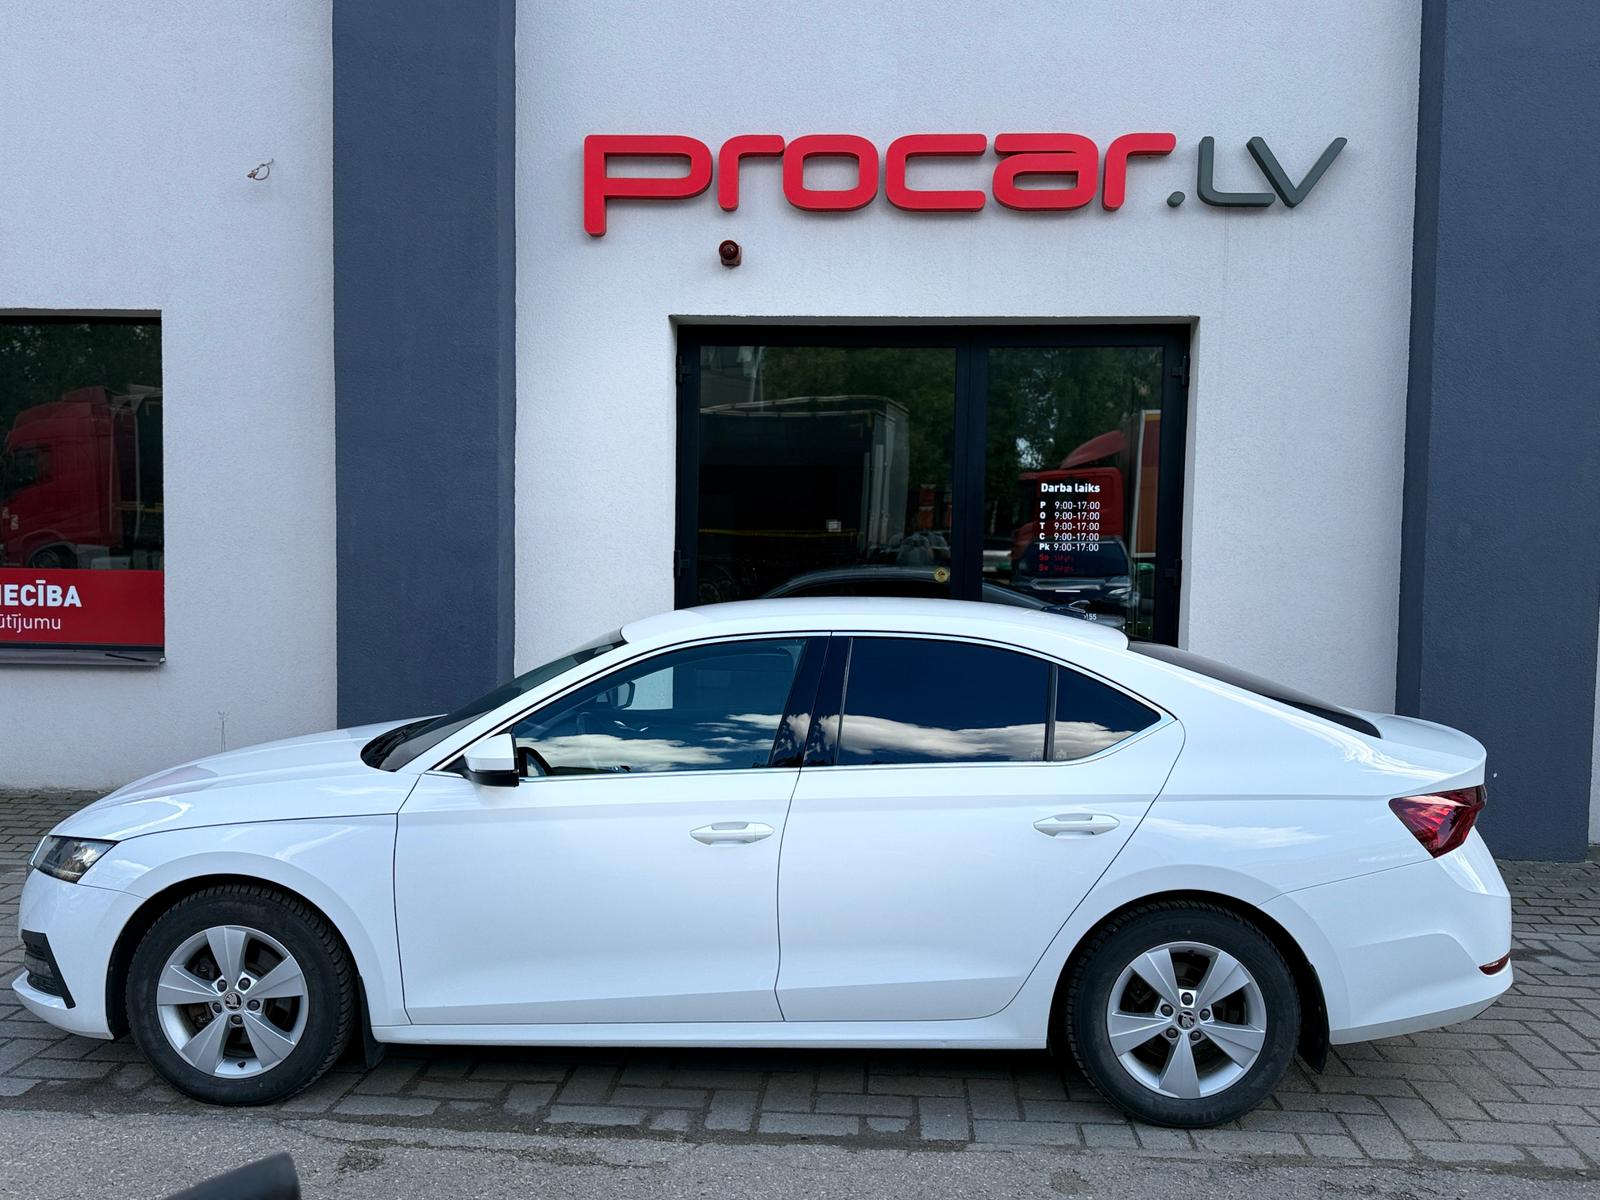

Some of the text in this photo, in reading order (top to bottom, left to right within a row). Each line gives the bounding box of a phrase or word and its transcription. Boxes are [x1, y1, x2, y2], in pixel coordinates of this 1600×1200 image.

[1041, 483, 1100, 492] Darba laiks
[1040, 501, 1100, 510] P 9:00-17:00
[1054, 511, 1100, 520] 9:00-17:00
[1039, 522, 1100, 531] T 9:00-17:00
[1039, 532, 1099, 541] C 9:00-17:00
[1039, 543, 1099, 552] Pk 9:00-17:00
[0, 580, 82, 607] ECĪBA
[1084, 612, 1097, 621] 155
